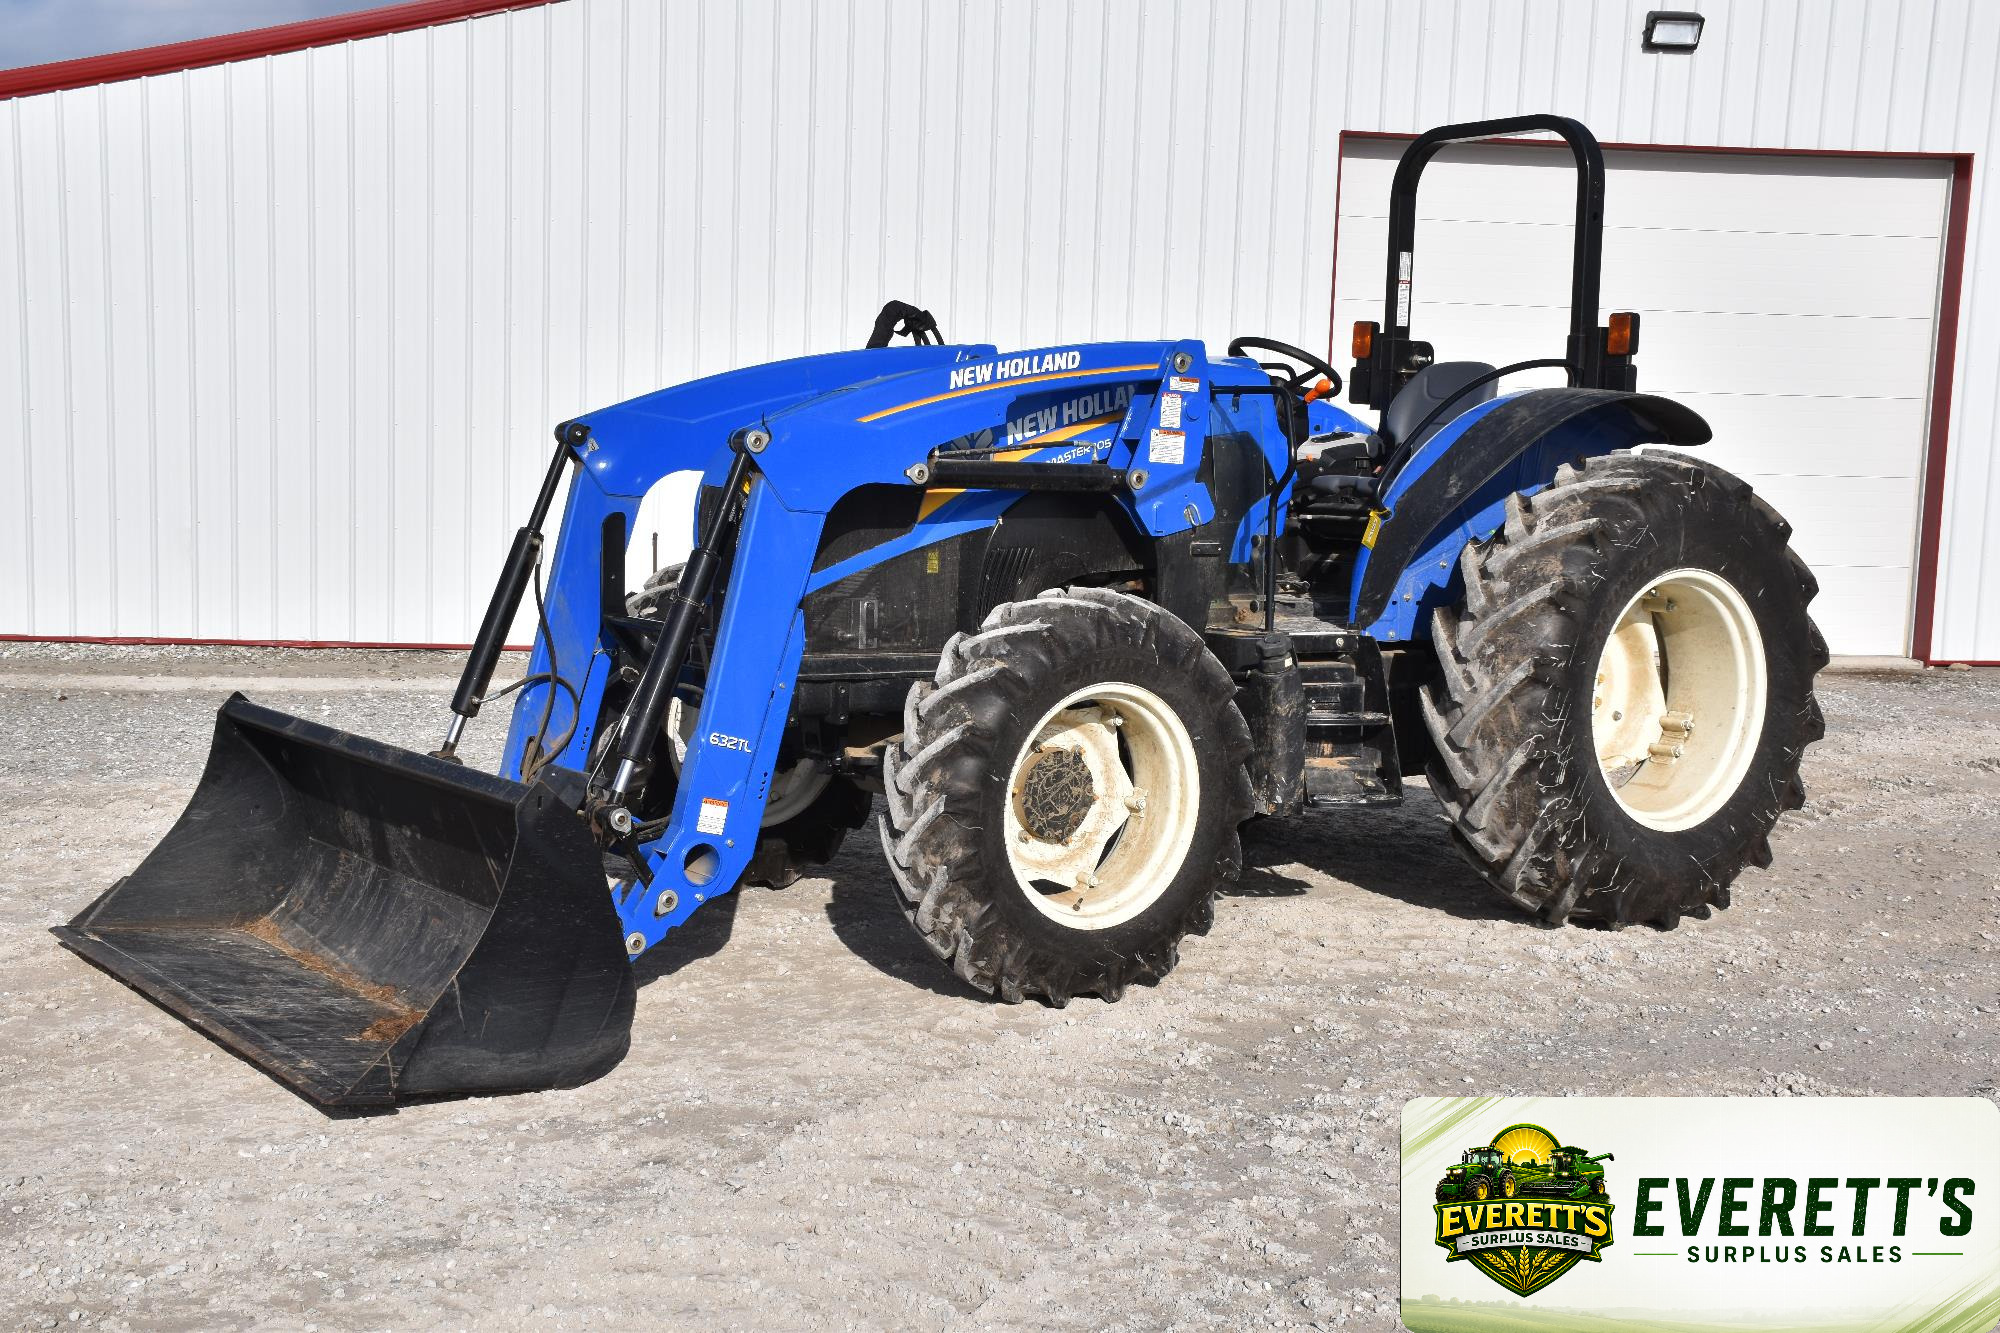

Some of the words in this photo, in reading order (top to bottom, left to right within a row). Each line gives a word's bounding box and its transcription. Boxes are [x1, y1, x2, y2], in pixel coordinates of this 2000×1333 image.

[949, 363, 994, 390] NEW
[996, 351, 1081, 380] HOLLAND
[1006, 405, 1058, 446] NEW
[709, 732, 752, 754] 632TL
